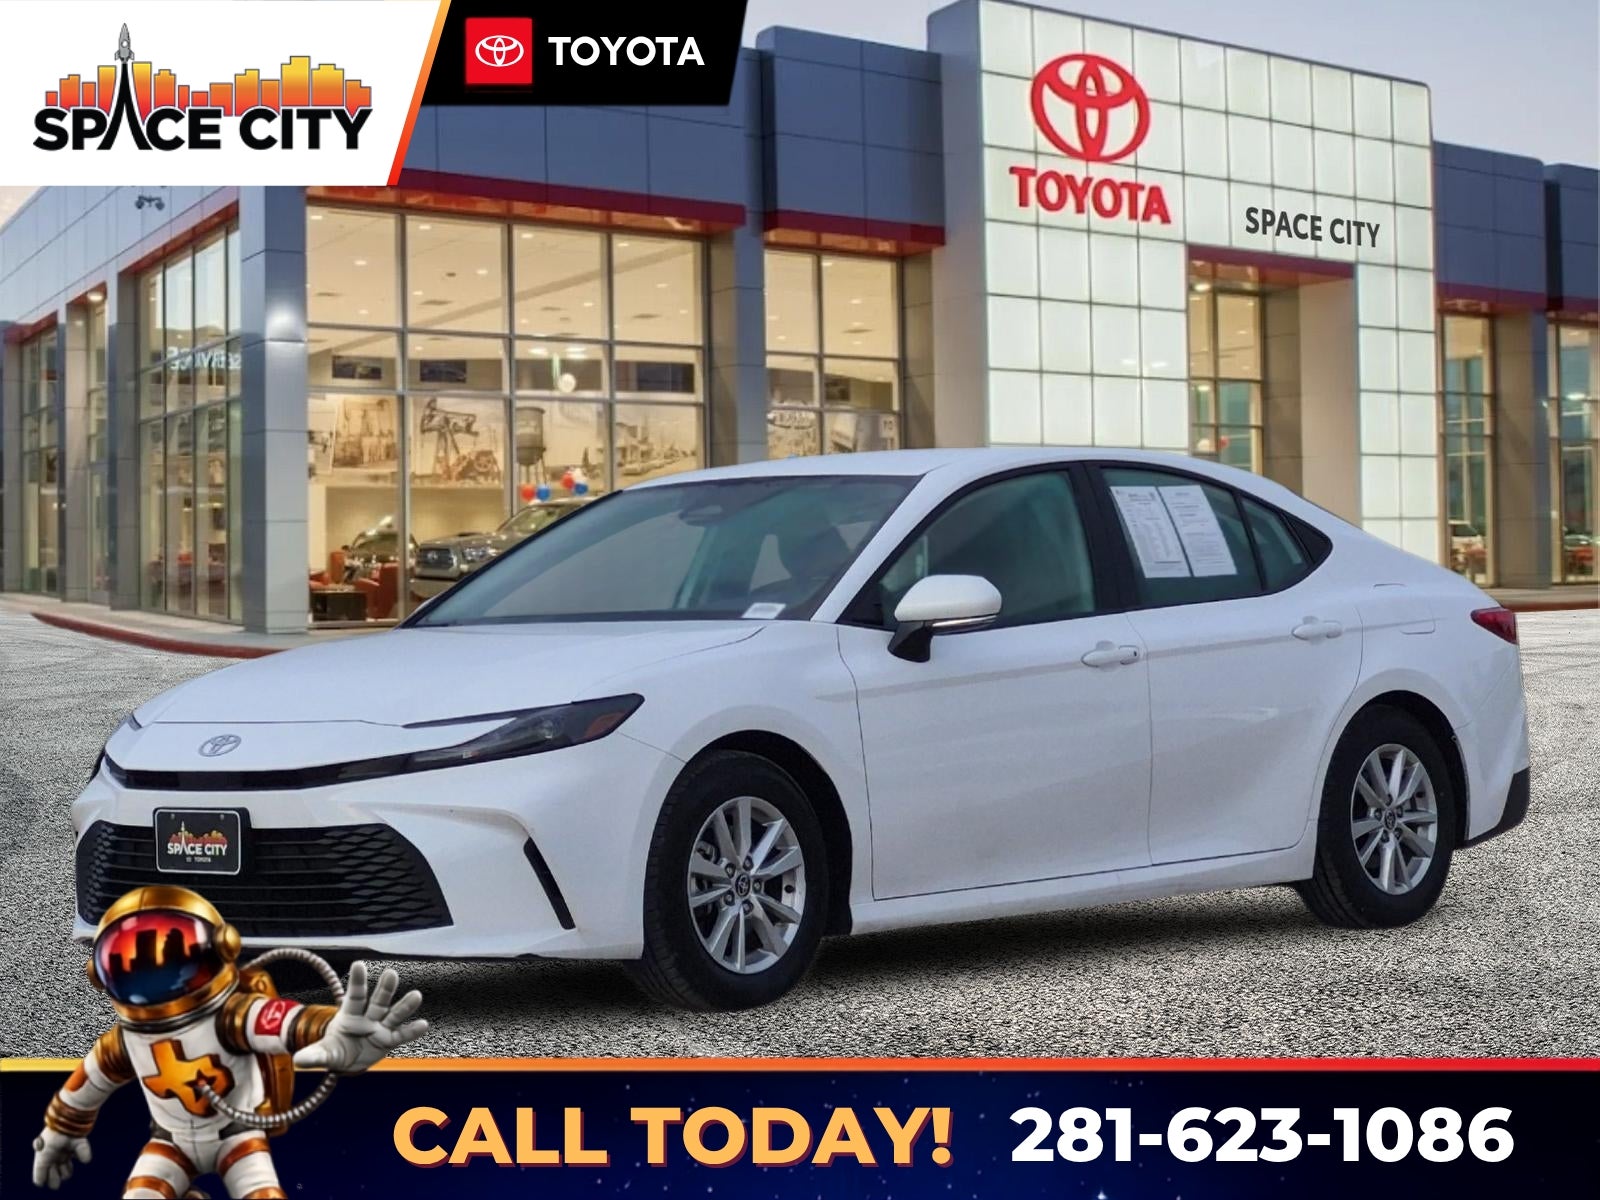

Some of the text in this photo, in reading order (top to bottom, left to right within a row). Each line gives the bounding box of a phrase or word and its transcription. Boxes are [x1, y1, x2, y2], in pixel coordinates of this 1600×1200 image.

[1009, 166, 1171, 224] TOYOTA
[1245, 206, 1381, 248] SPACE CITY
[167, 842, 228, 856] SPACE CITY
